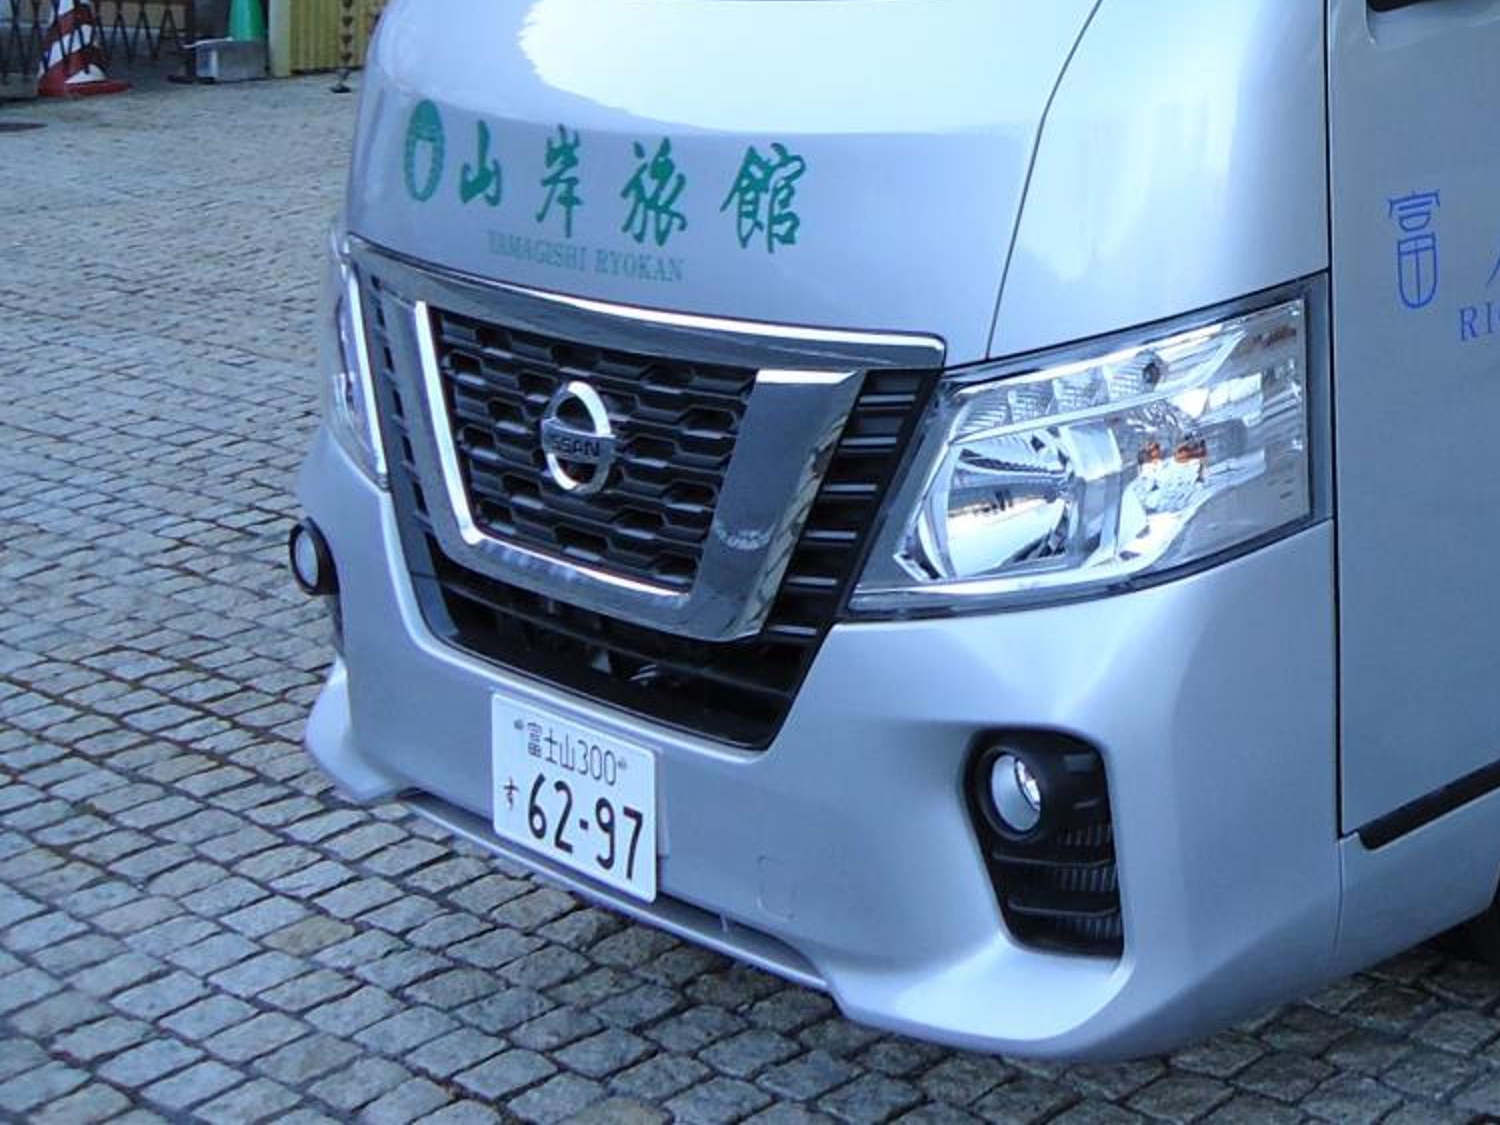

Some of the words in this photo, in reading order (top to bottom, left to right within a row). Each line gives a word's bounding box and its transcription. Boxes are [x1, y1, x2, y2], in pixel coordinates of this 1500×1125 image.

[459, 119, 807, 254] 山岸旅館
[486, 229, 588, 272] YAMAGISHI
[594, 247, 687, 282] RYOKAN
[528, 773, 644, 881] 62-97
